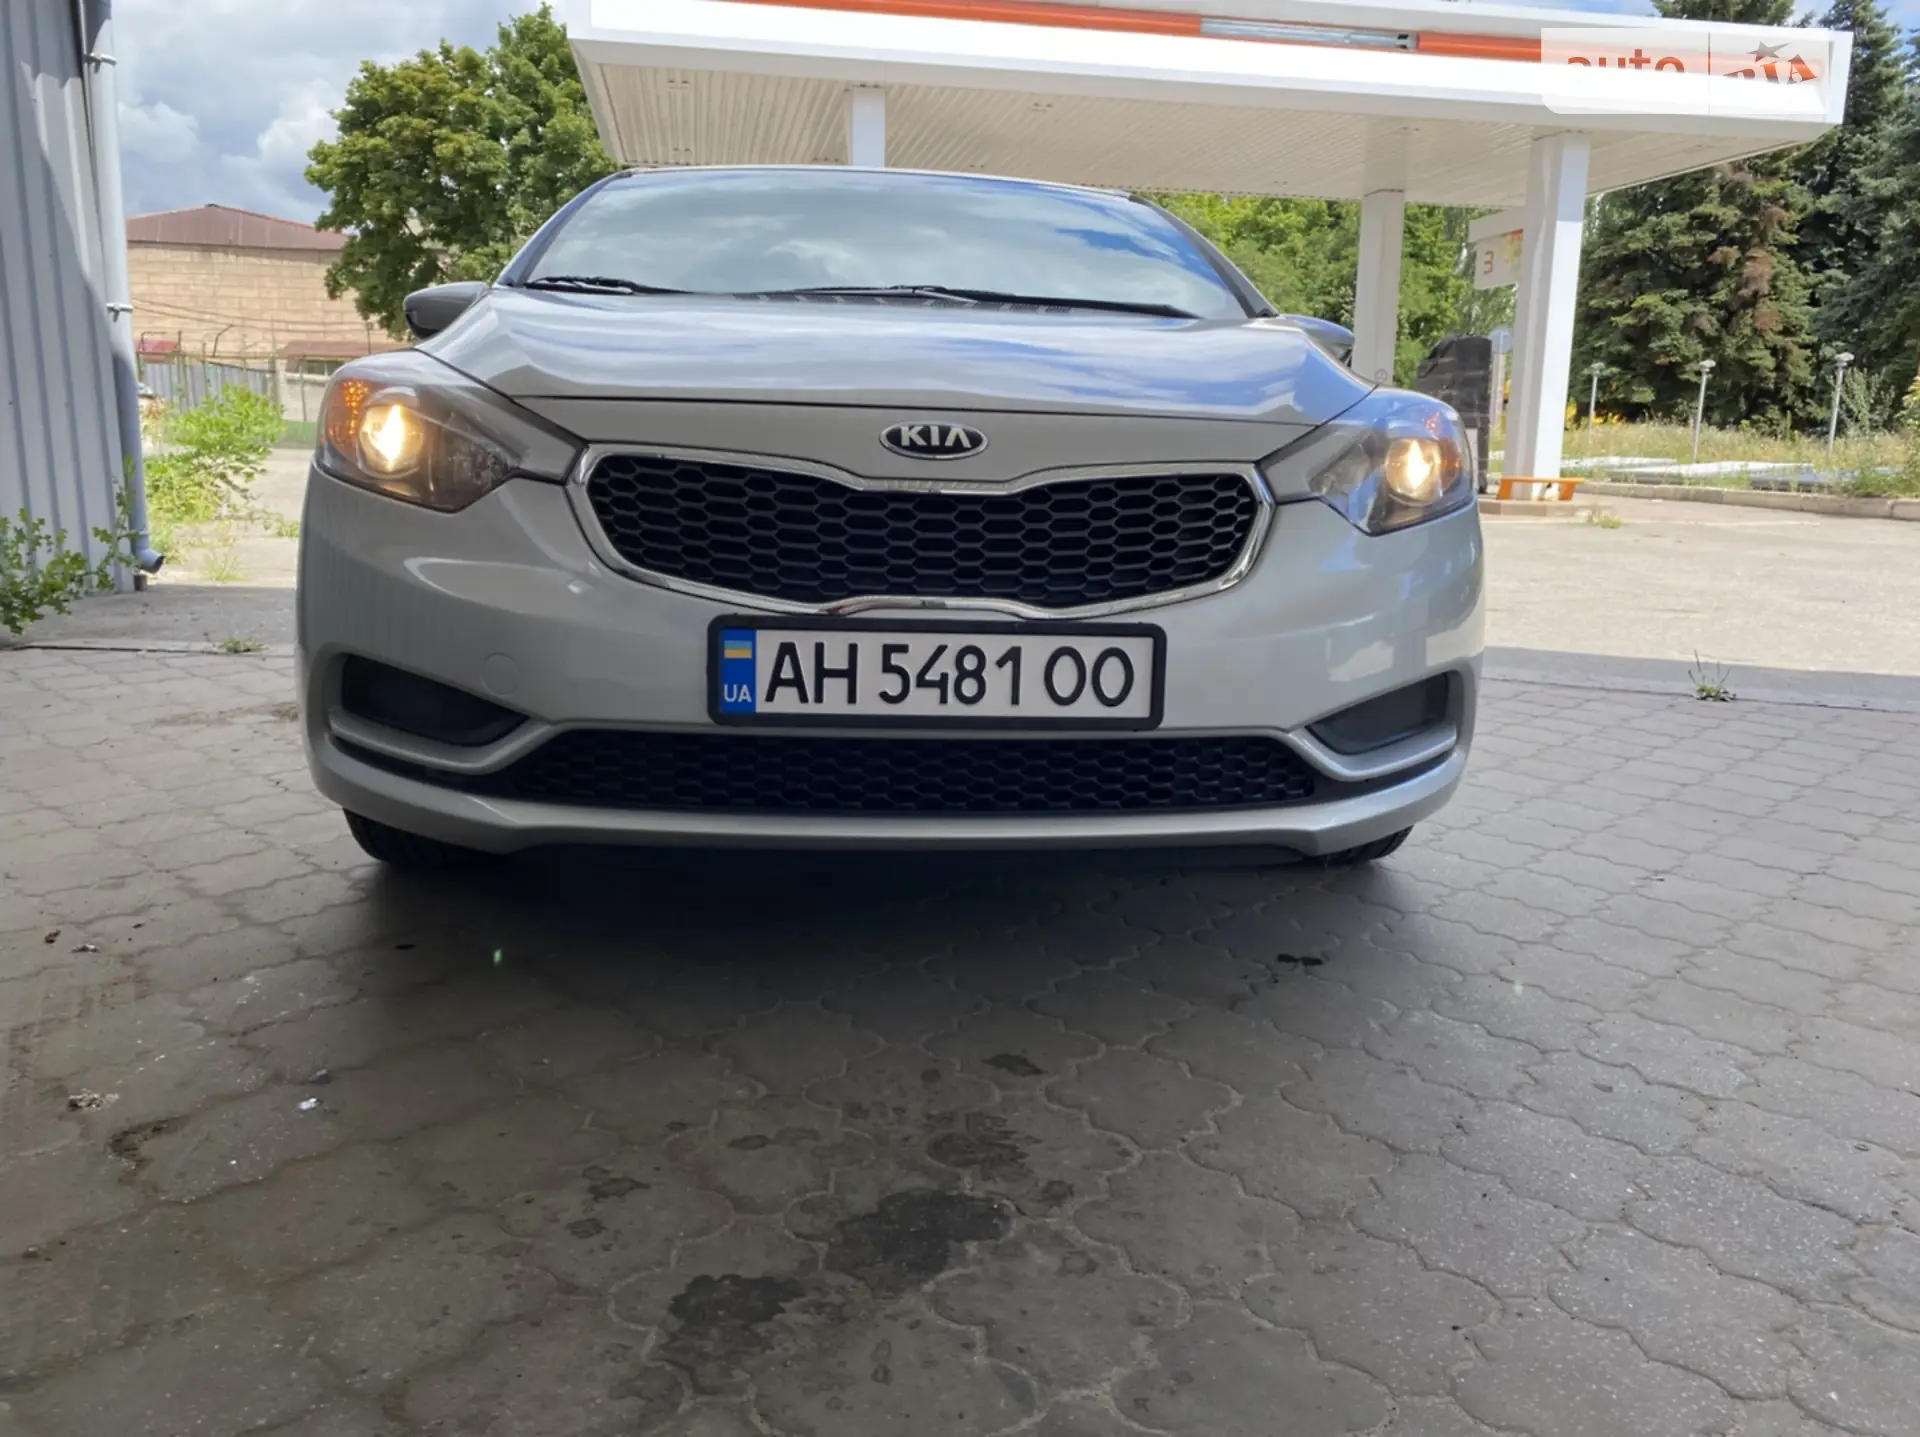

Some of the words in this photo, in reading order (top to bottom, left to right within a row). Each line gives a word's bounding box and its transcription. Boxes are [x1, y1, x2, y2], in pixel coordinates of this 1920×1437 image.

[901, 425, 972, 449] KIA
[765, 641, 858, 704] AH
[878, 643, 1023, 706] 5481
[1044, 645, 1135, 707] OO
[723, 683, 752, 703] UA
